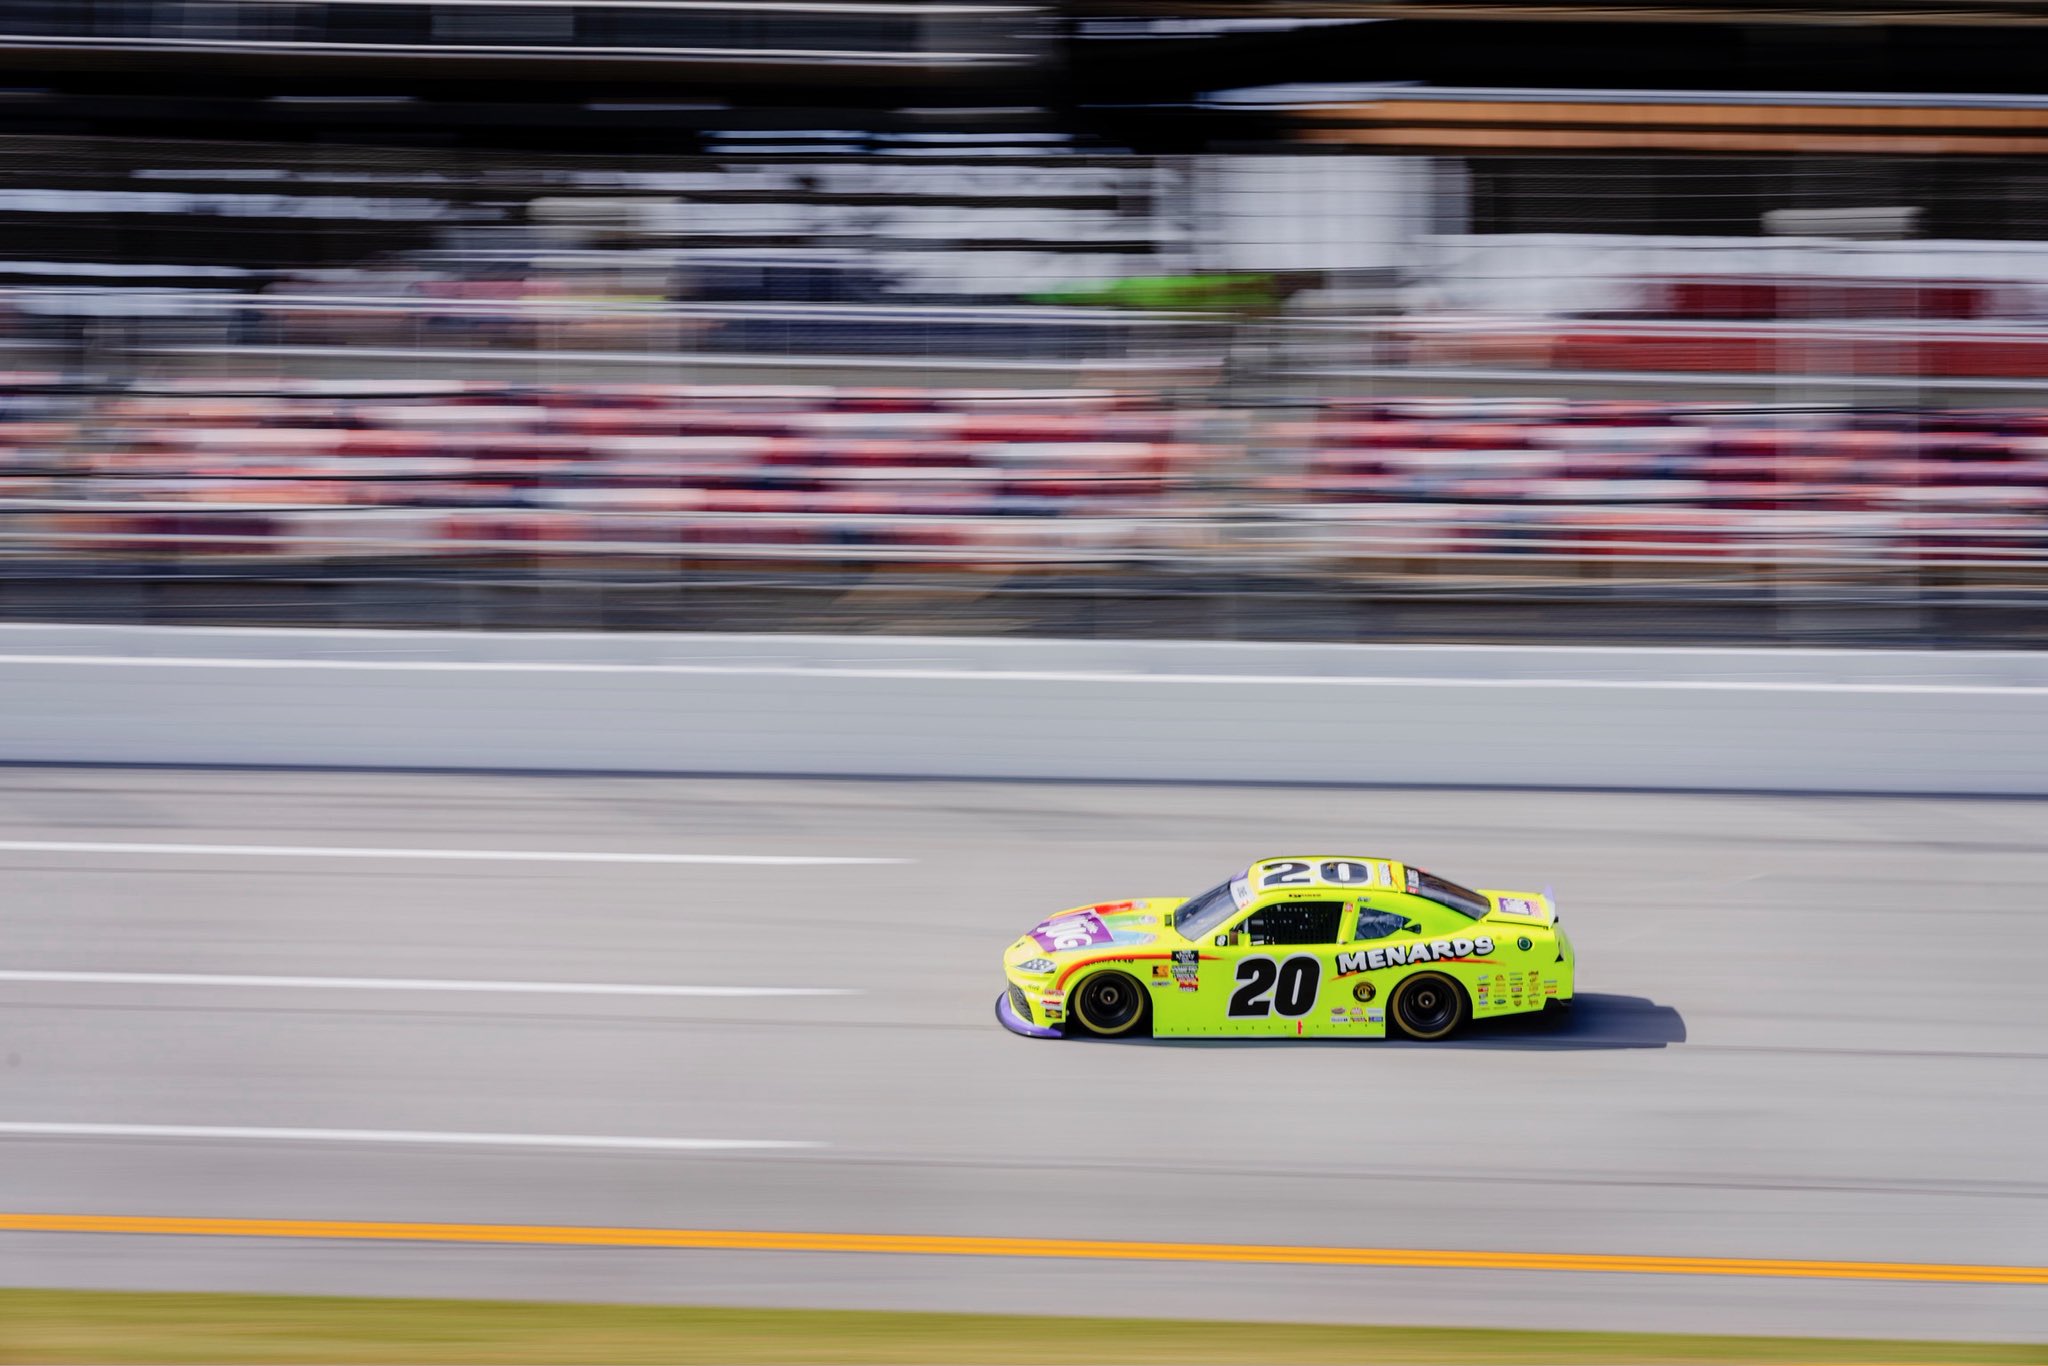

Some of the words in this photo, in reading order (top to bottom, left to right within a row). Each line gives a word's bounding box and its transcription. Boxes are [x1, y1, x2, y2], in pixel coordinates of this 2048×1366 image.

[1262, 861, 1369, 886] 20
[1336, 936, 1495, 976] MENARDS
[1227, 955, 1321, 1017] 20
